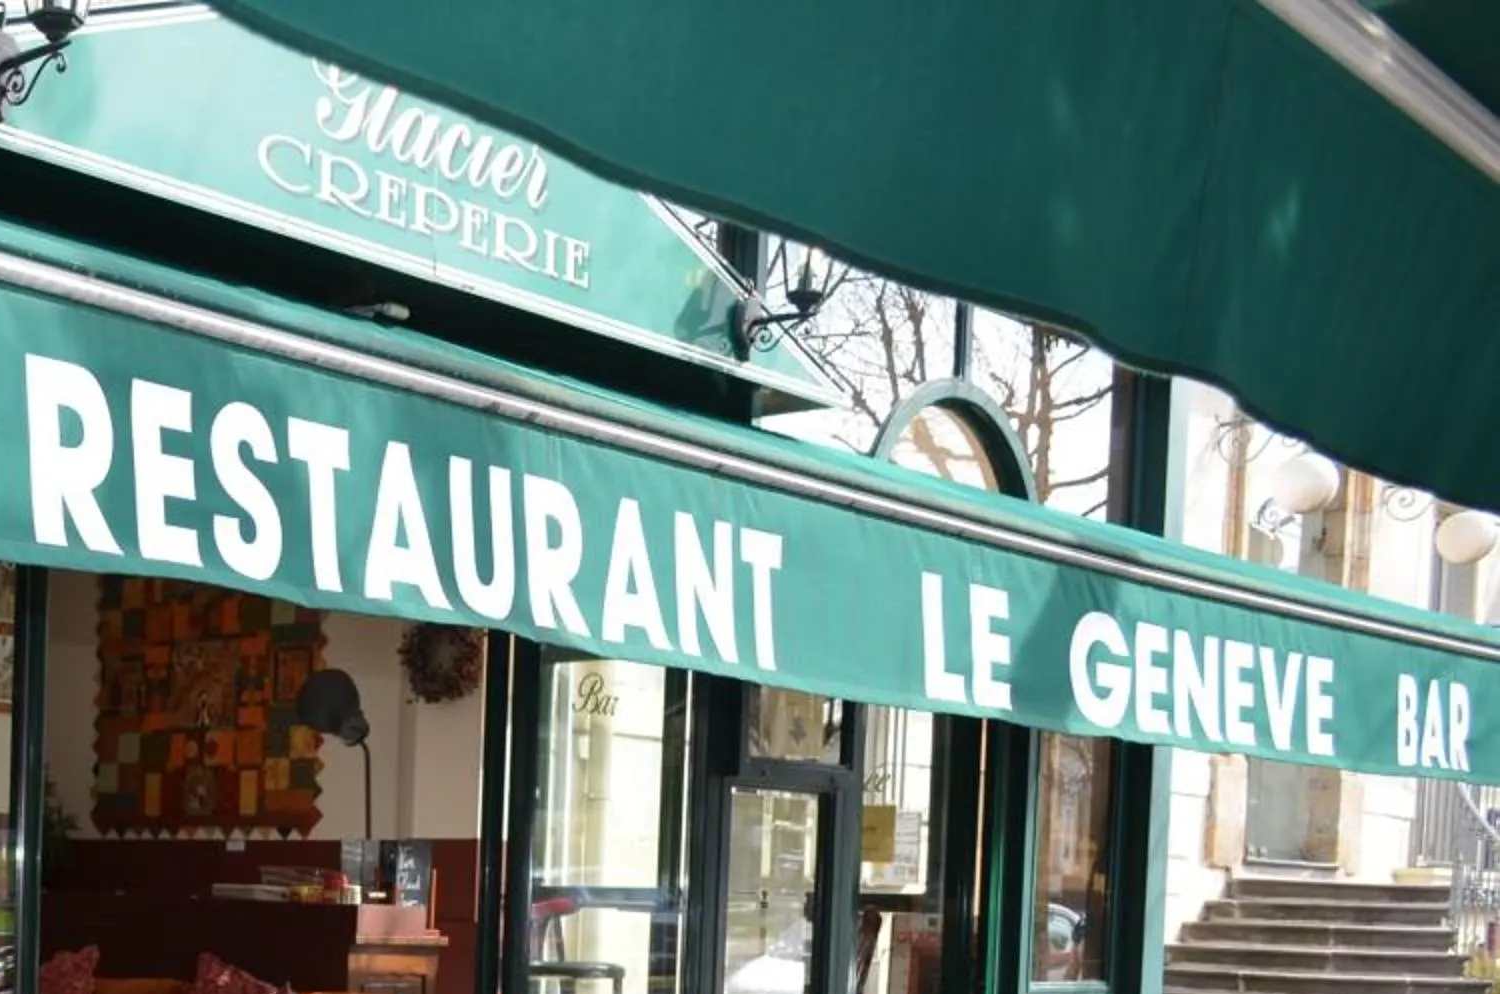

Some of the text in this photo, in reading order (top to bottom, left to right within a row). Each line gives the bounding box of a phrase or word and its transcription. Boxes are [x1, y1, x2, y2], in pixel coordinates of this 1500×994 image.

[312, 57, 548, 208] Glacier
[258, 133, 590, 289] CREPERIE
[25, 353, 783, 671] RESTAURANT
[921, 572, 1013, 710] LE
[1068, 611, 1335, 756] GENEVE
[1397, 673, 1471, 772] BAR
